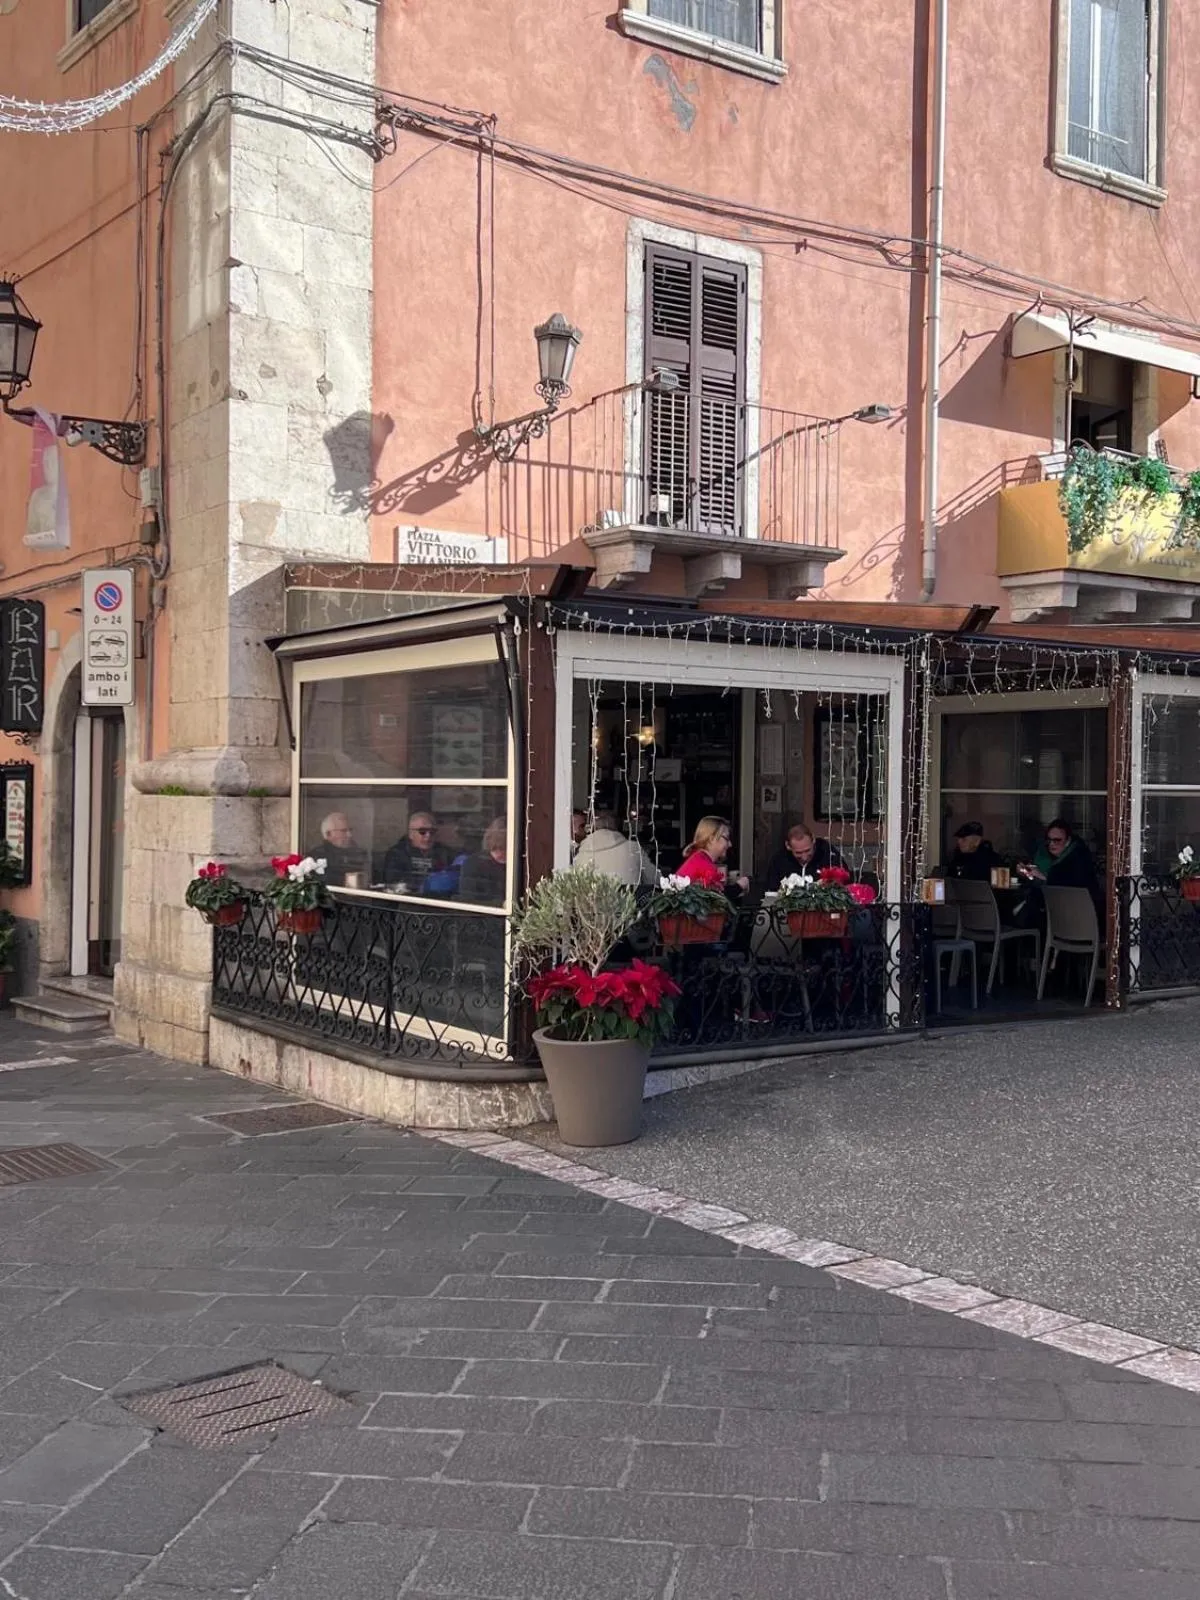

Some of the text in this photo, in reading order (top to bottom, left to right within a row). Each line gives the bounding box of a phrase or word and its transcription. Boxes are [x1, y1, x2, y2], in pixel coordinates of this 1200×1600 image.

[407, 531, 441, 543] PIAZZA
[407, 541, 477, 560] VITTORIO
[8, 607, 39, 722] BAR
[88, 671, 128, 682] ambo i
[98, 686, 118, 698] lati
